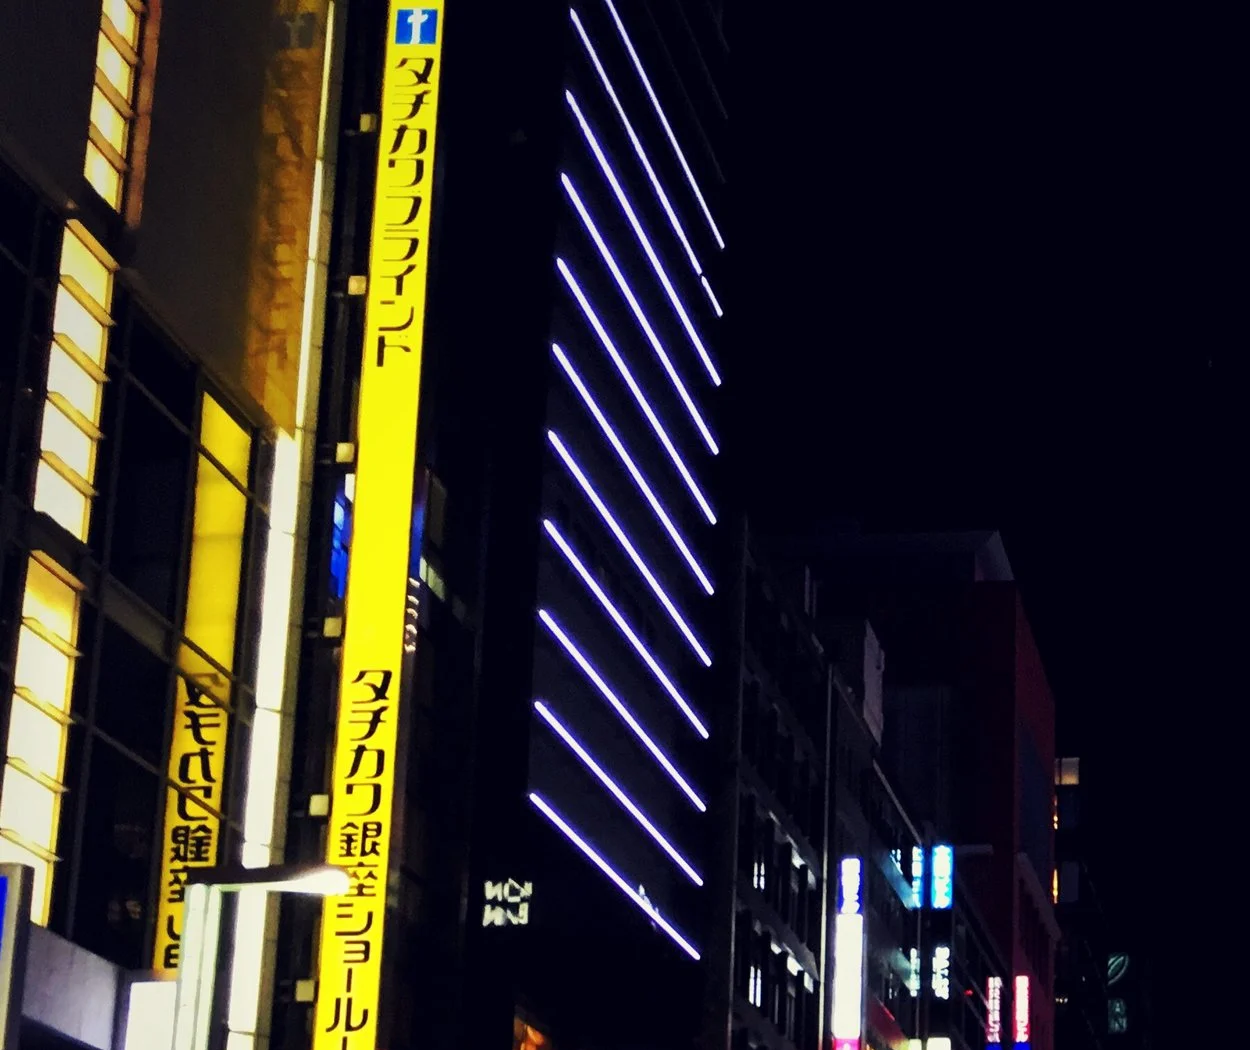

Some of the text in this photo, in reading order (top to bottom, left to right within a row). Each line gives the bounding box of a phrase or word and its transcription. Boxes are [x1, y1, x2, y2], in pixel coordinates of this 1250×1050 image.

[376, 57, 434, 367] タチカワブラインド
